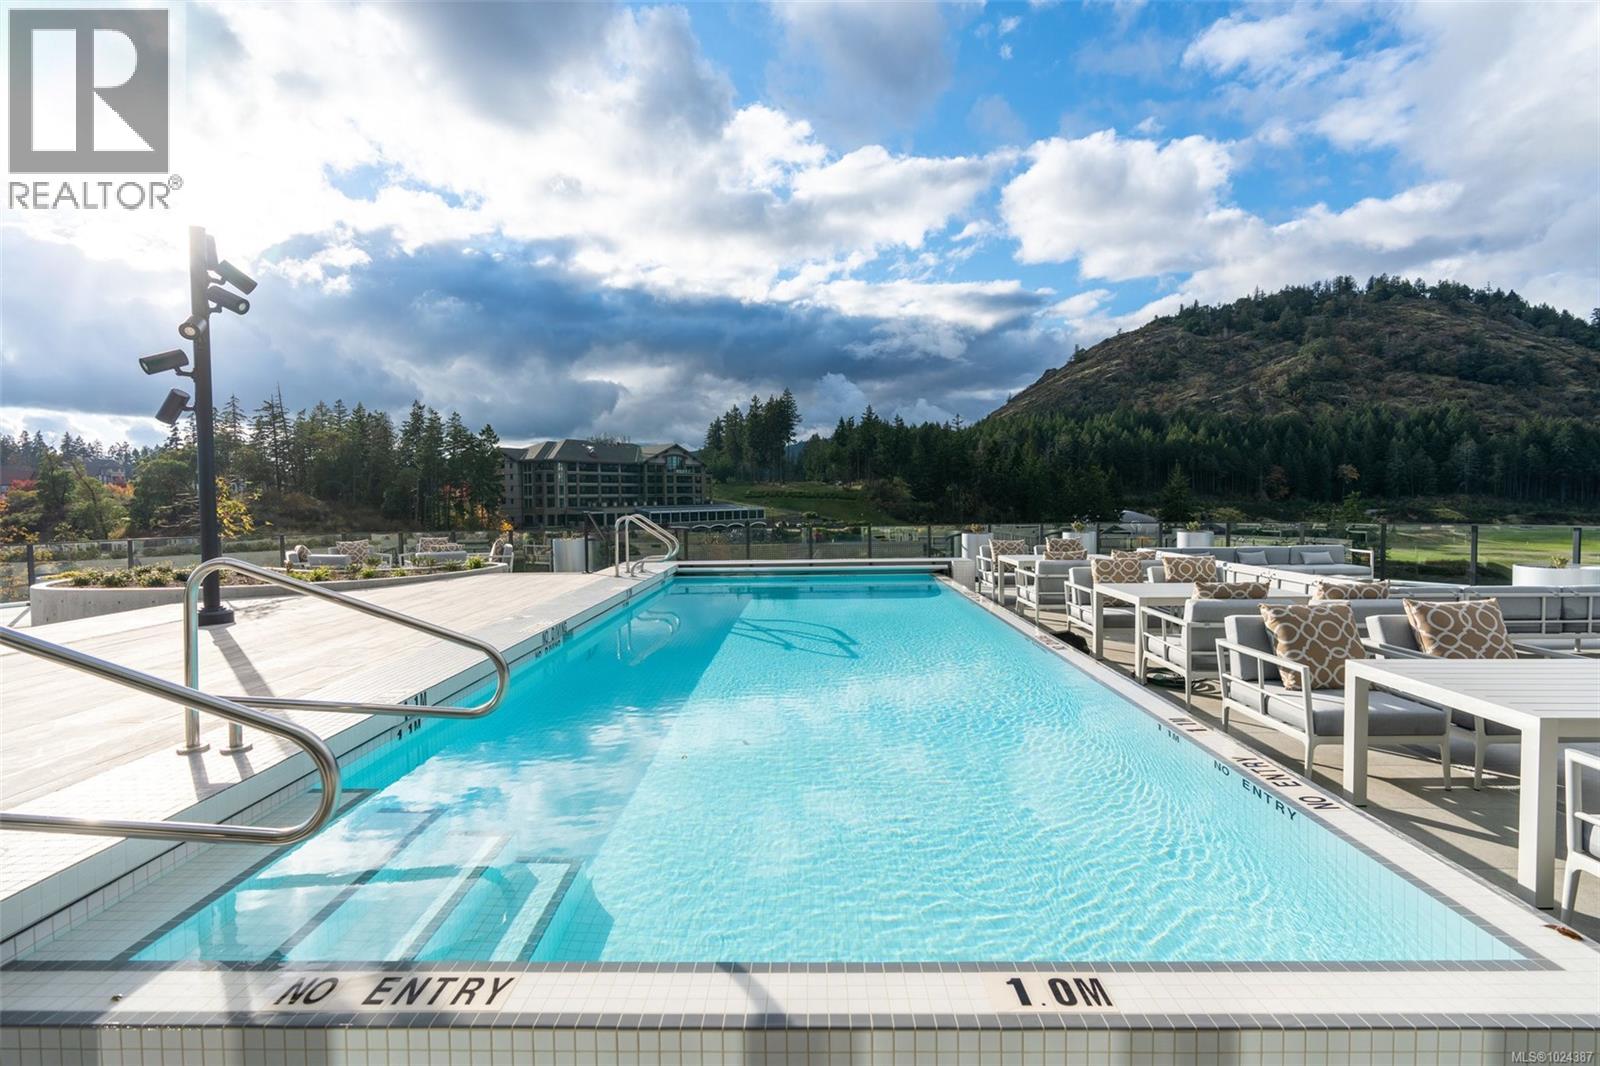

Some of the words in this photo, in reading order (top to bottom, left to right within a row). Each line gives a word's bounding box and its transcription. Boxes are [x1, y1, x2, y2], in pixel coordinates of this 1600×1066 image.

[1231, 755, 1303, 788] ENTRY
[1213, 759, 1231, 777] NO
[1242, 777, 1298, 821] ENTRY
[1298, 795, 1341, 811] NO
[273, 976, 340, 1006] NO
[361, 976, 516, 1006] ENTRY
[1005, 977, 1114, 1007] 1.0M
